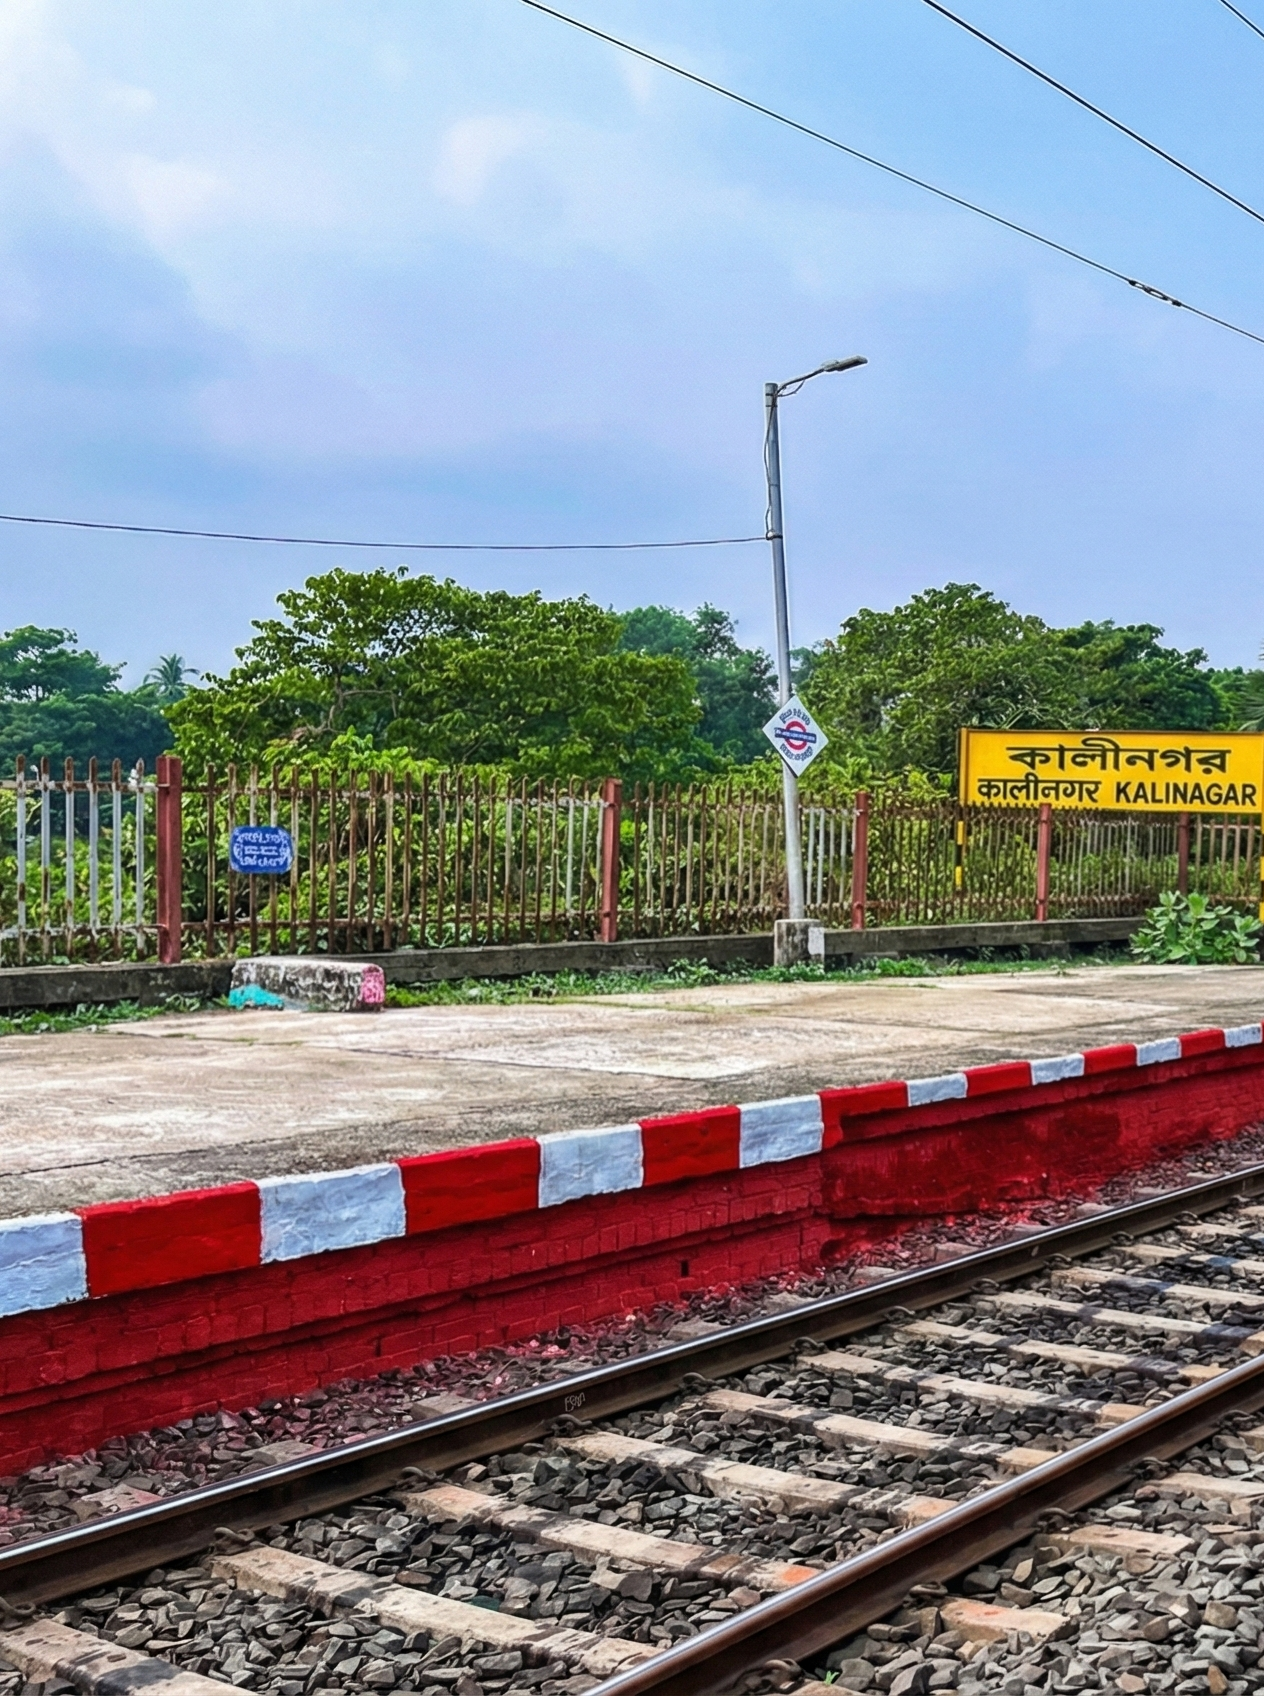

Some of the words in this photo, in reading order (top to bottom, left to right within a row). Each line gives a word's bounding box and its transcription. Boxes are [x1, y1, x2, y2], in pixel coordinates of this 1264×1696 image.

[1006, 737, 1231, 775] কালীনগর
[977, 772, 1102, 803] कालीनगर
[1115, 781, 1257, 807] KALINAGAR
